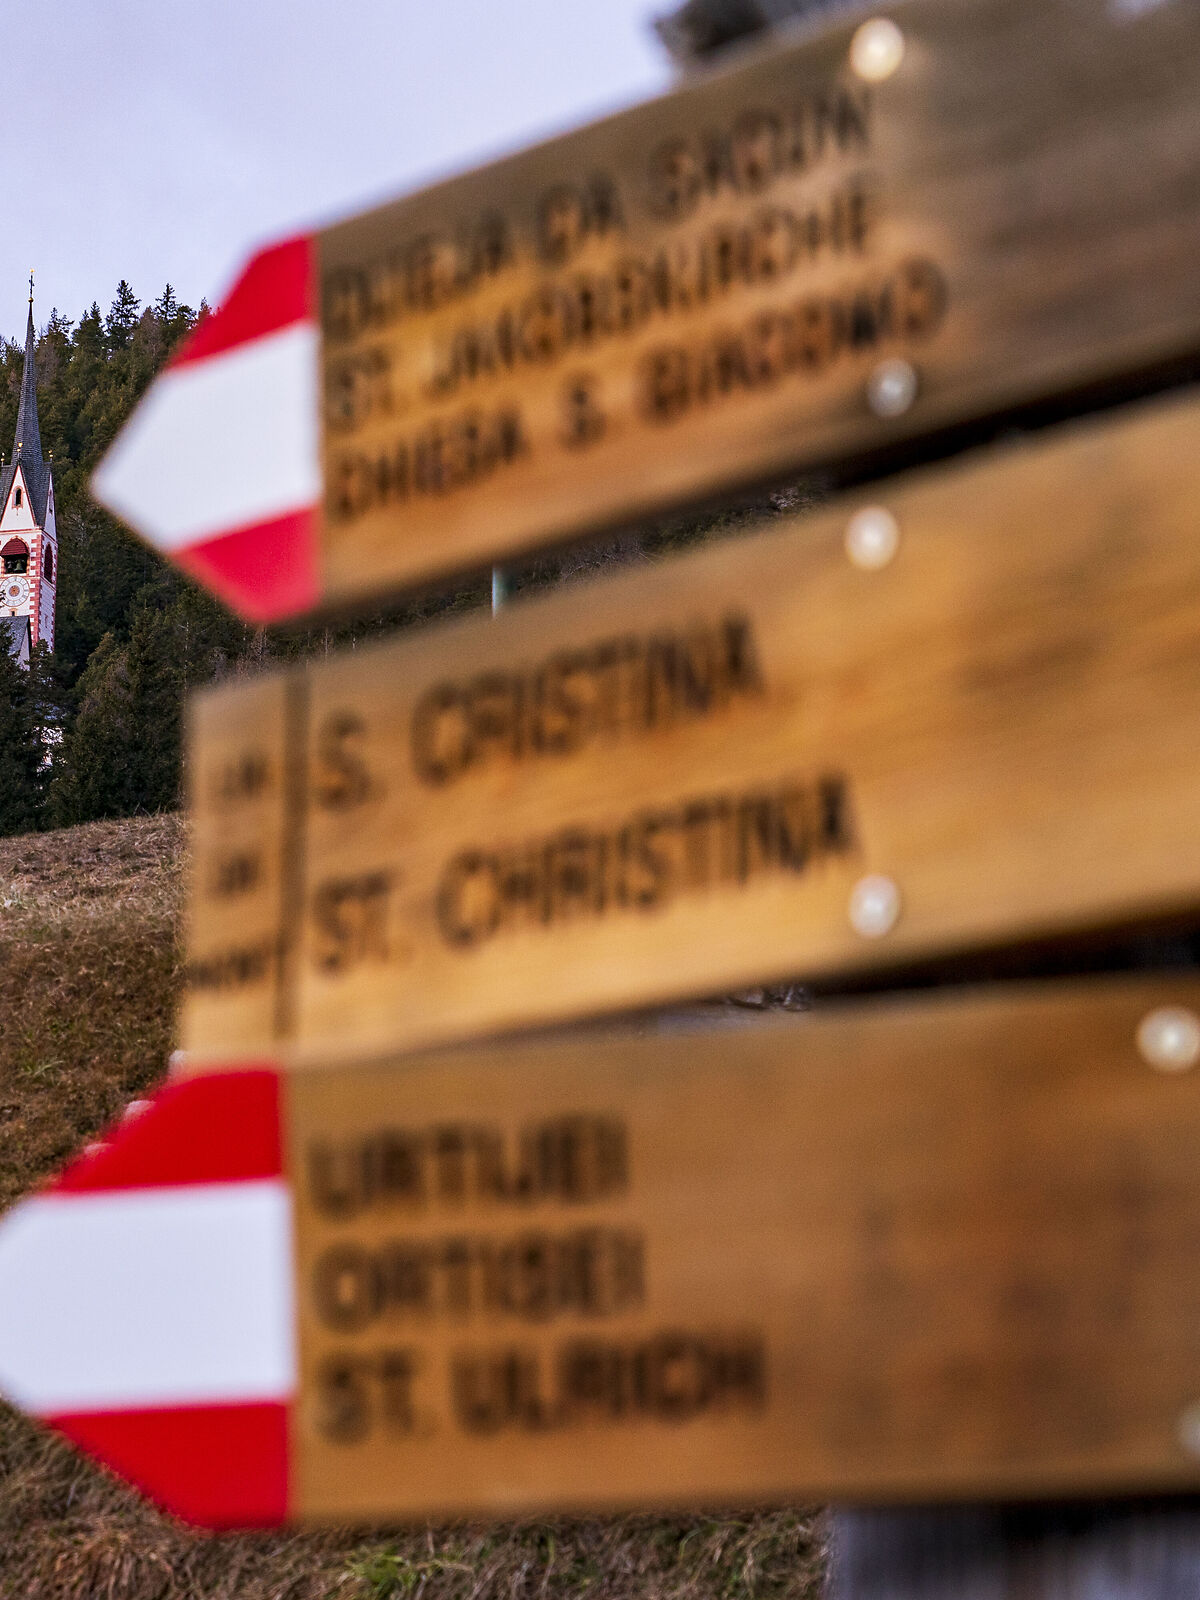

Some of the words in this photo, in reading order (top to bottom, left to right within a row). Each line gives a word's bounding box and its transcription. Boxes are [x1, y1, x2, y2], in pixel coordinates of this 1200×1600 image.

[409, 606, 766, 789] CRISTINA
[311, 862, 411, 980] ST.
[436, 766, 862, 954] CHRISTINA
[311, 1223, 646, 1336] ORTISEI
[450, 1326, 765, 1437] ULRICH
